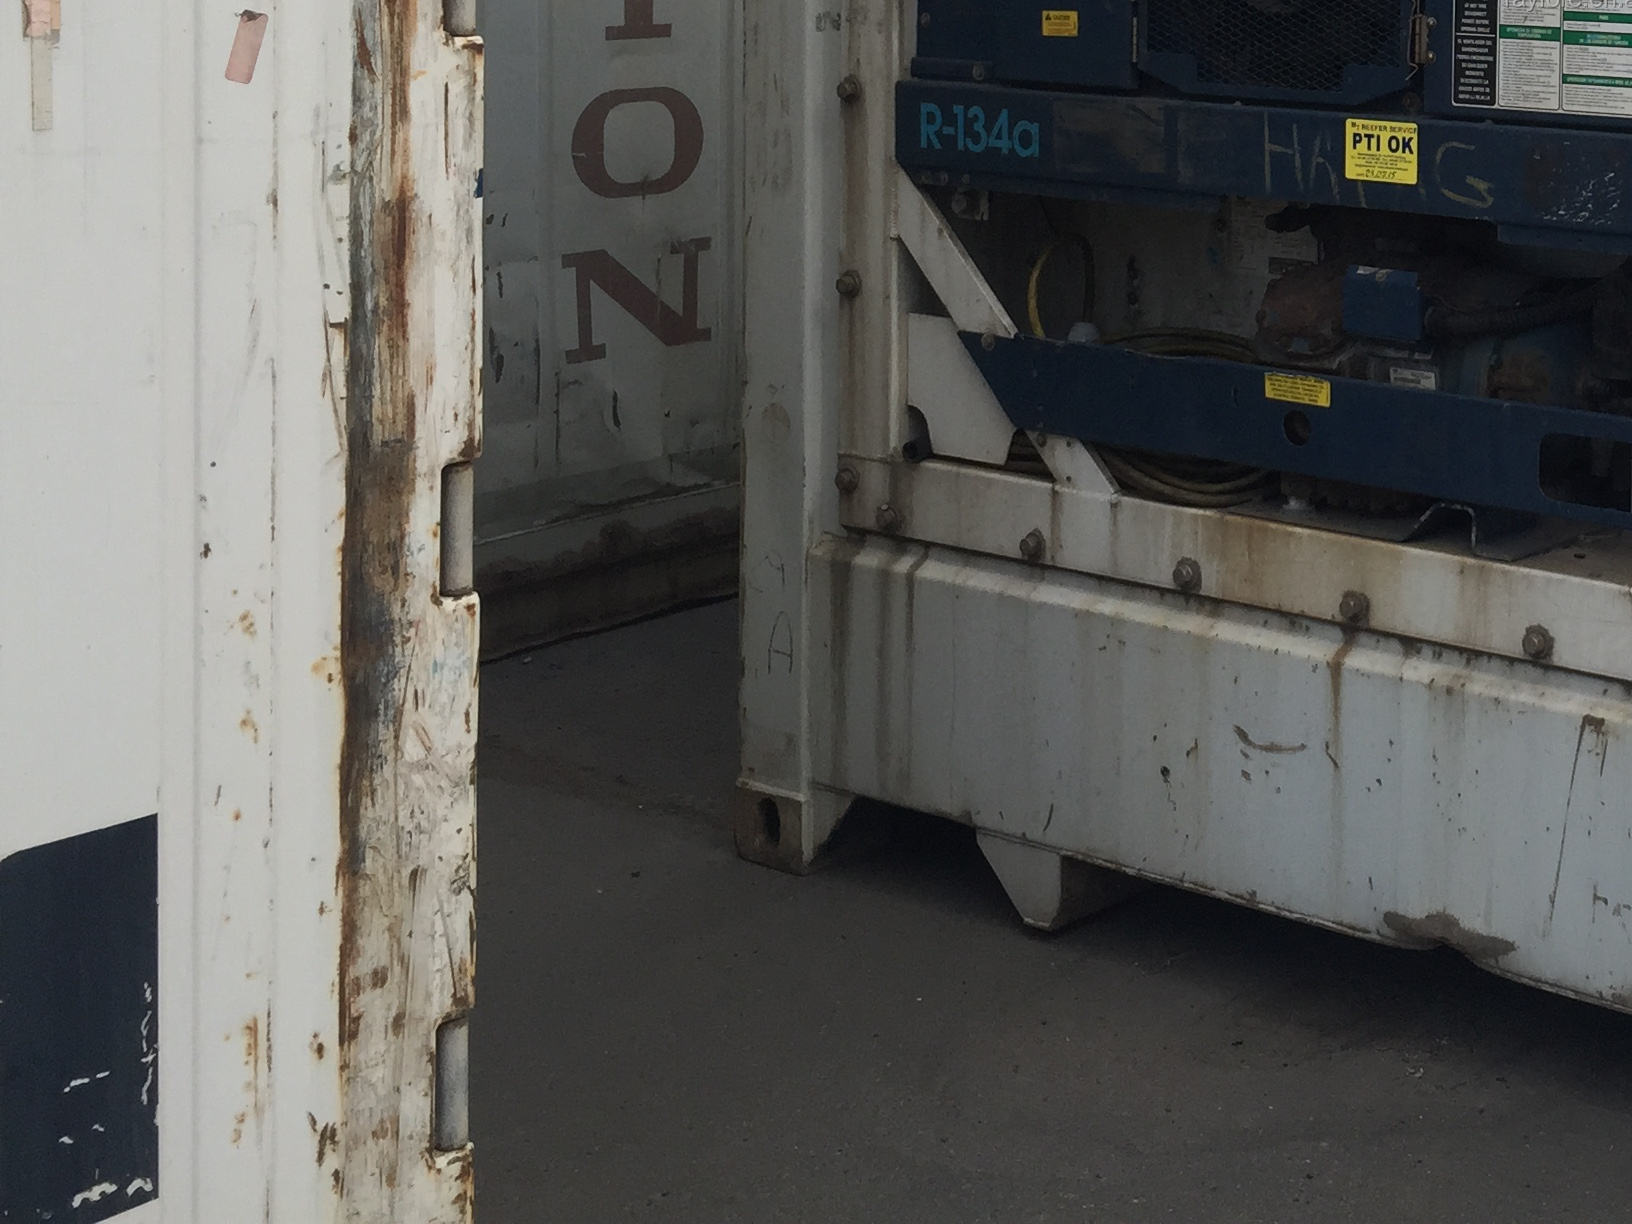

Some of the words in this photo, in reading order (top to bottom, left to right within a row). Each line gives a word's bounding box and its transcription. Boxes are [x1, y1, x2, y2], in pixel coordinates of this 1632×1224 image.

[919, 102, 1040, 158] R-134a
[1361, 123, 1388, 133] REEFER
[1352, 132, 1381, 152] PTI
[1387, 135, 1414, 155] OK
